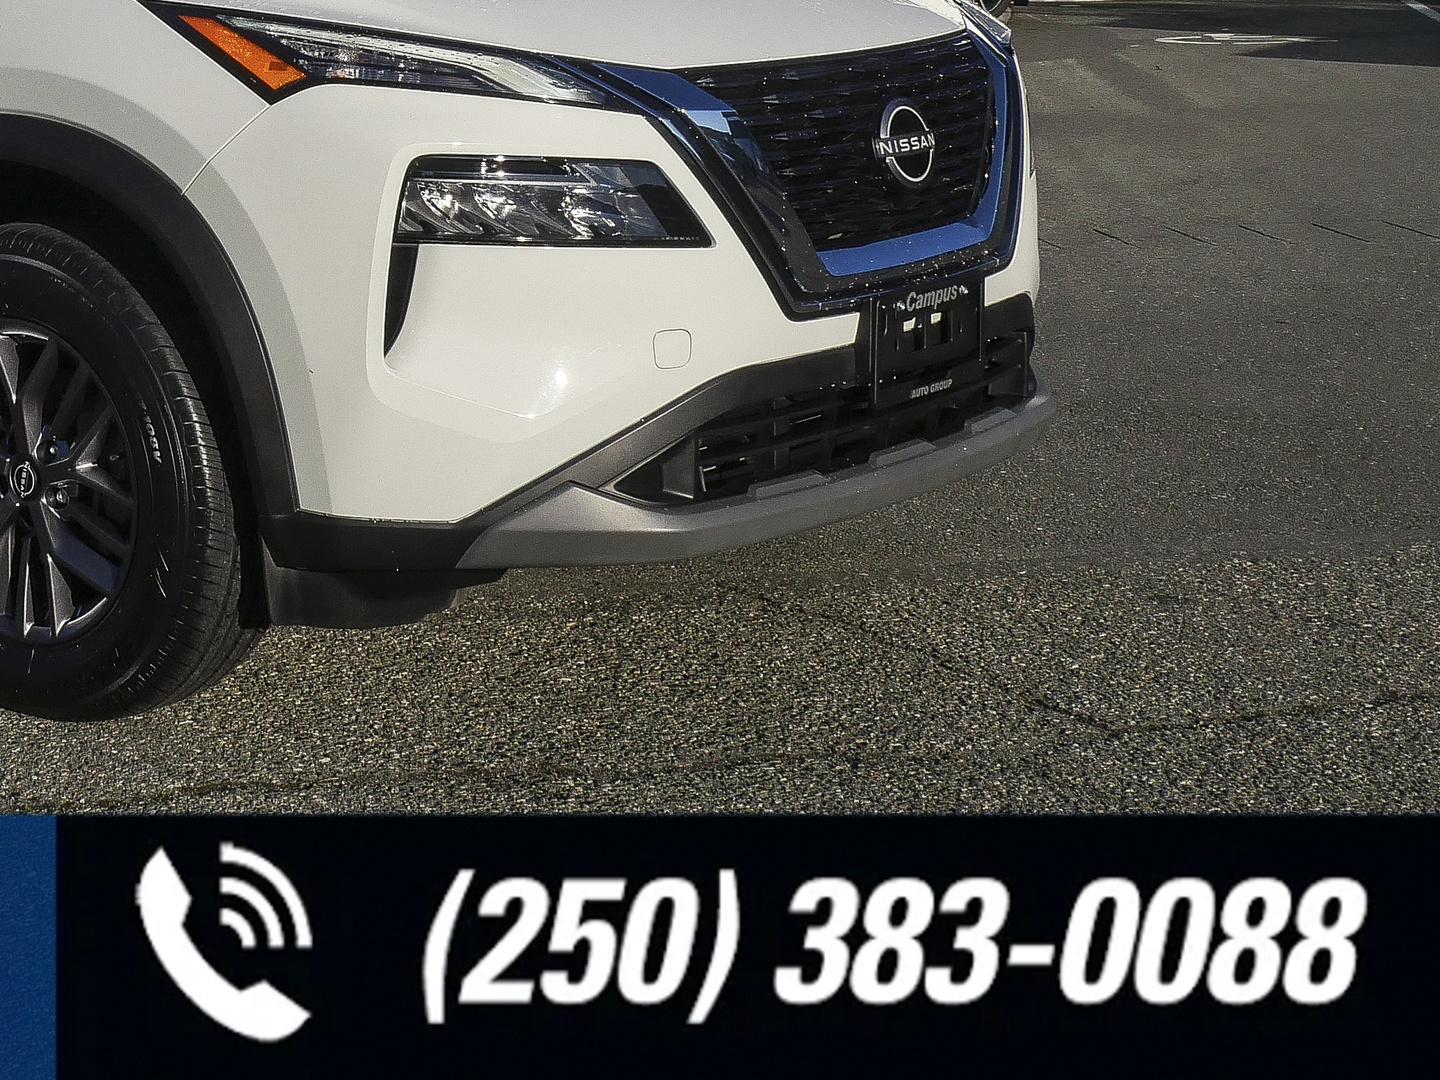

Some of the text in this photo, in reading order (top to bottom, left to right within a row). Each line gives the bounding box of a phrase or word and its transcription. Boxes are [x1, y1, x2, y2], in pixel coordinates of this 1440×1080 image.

[879, 132, 936, 155] NISSAN
[906, 284, 958, 312] Campus
[910, 378, 953, 399] AUTO GROUP
